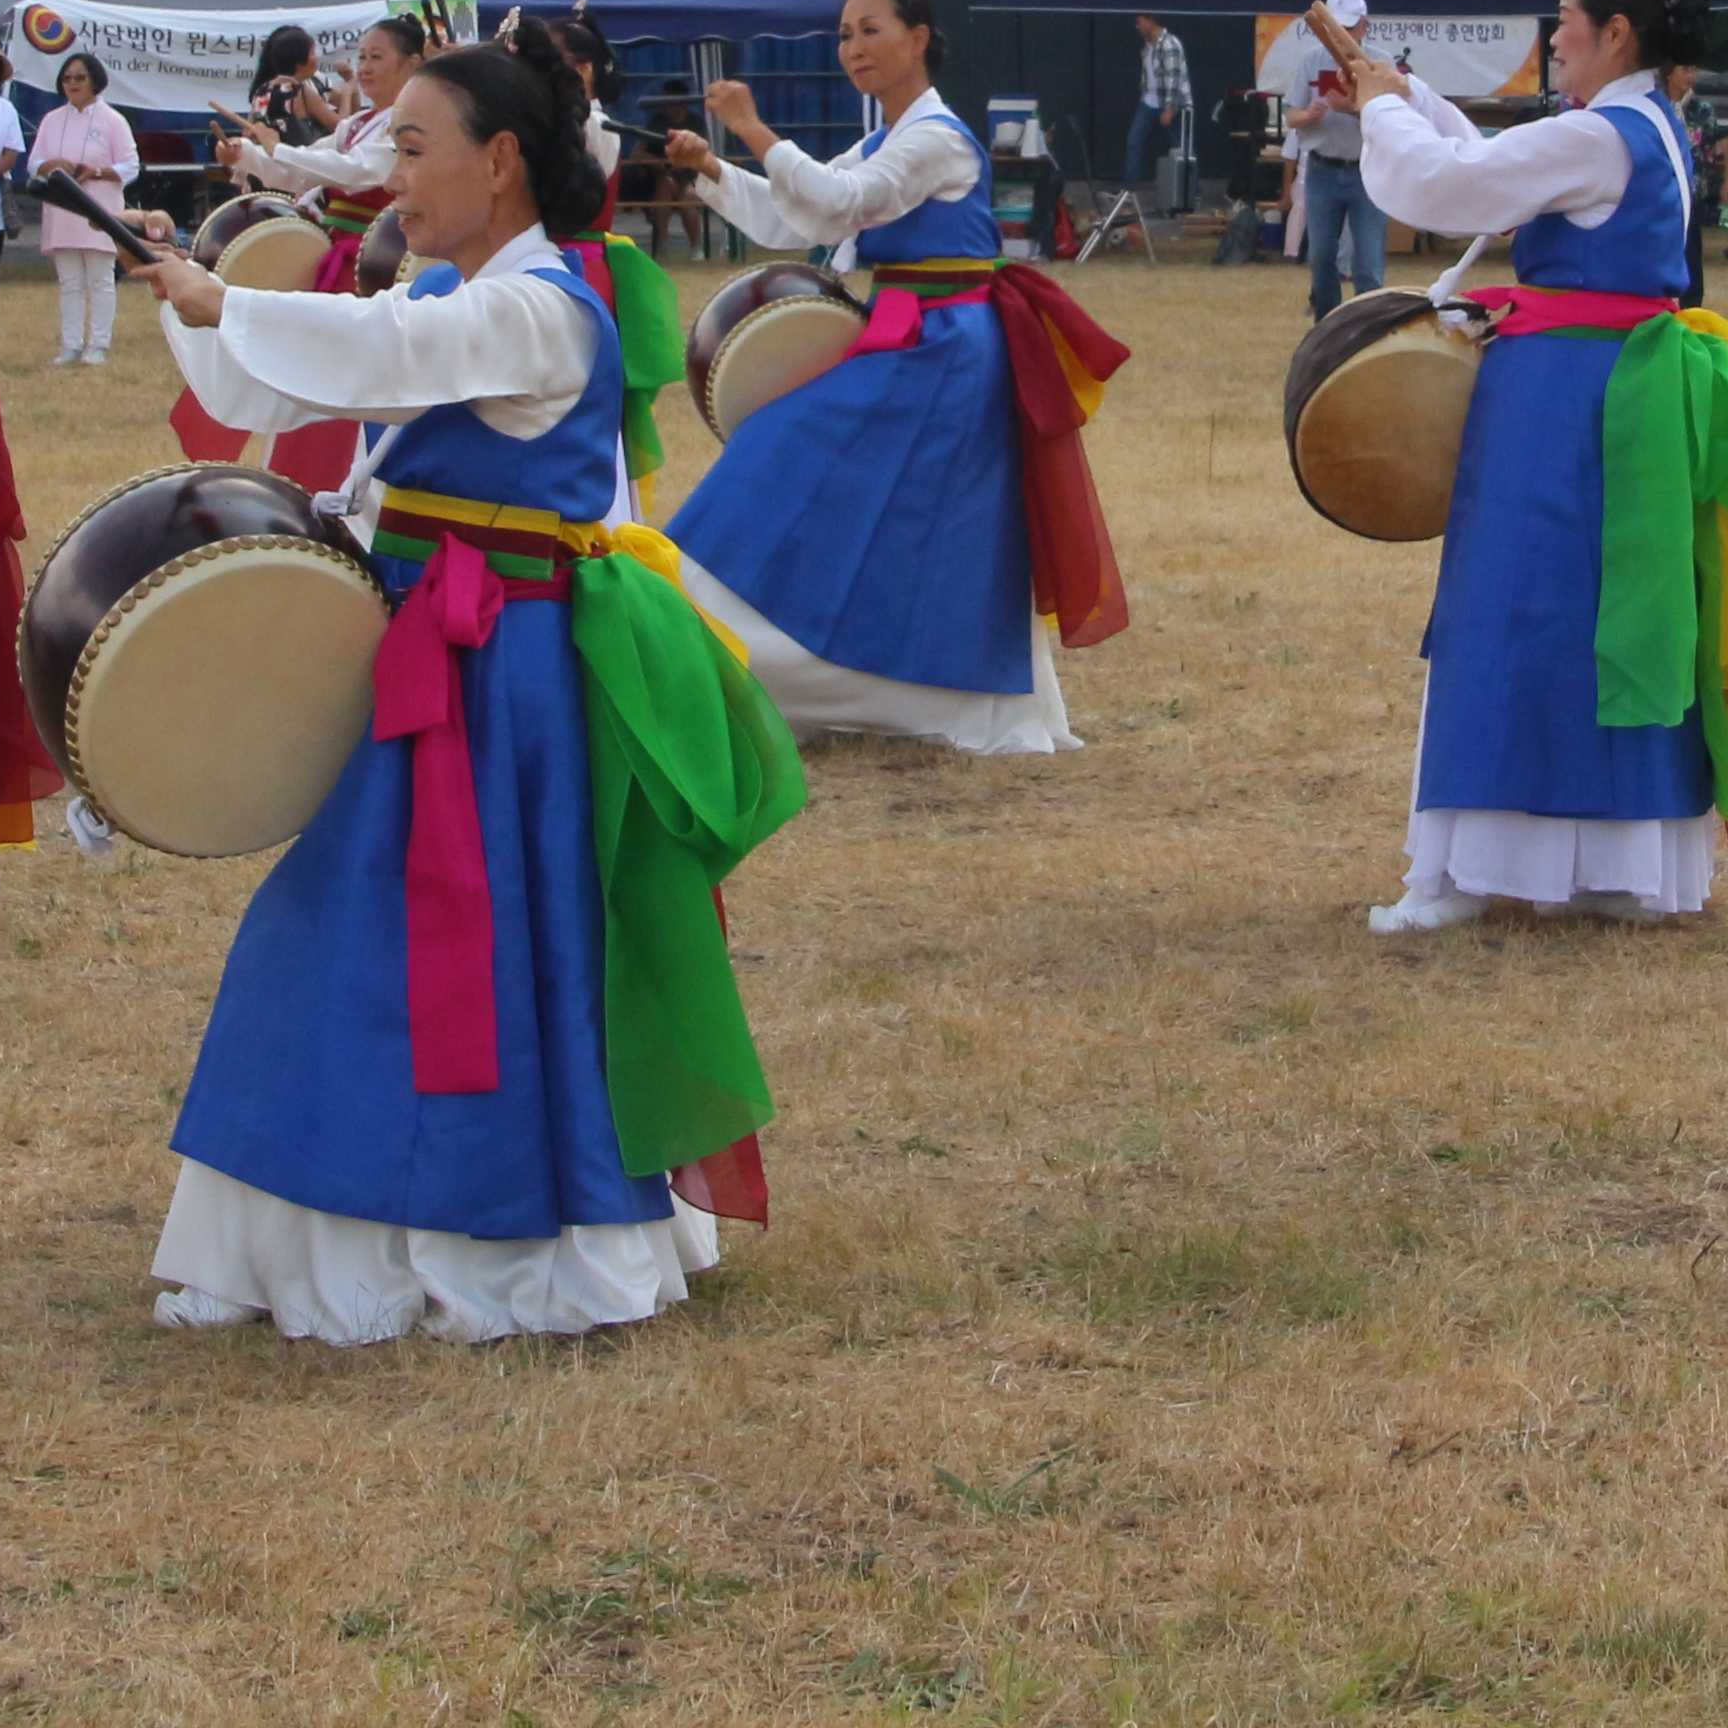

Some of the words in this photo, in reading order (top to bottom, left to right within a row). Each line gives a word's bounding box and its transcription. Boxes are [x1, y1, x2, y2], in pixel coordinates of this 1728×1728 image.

[78, 20, 173, 55] 사단법인
[1444, 22, 1506, 43] 총연합회
[126, 57, 152, 73] der
[157, 60, 231, 80] Koreaner
